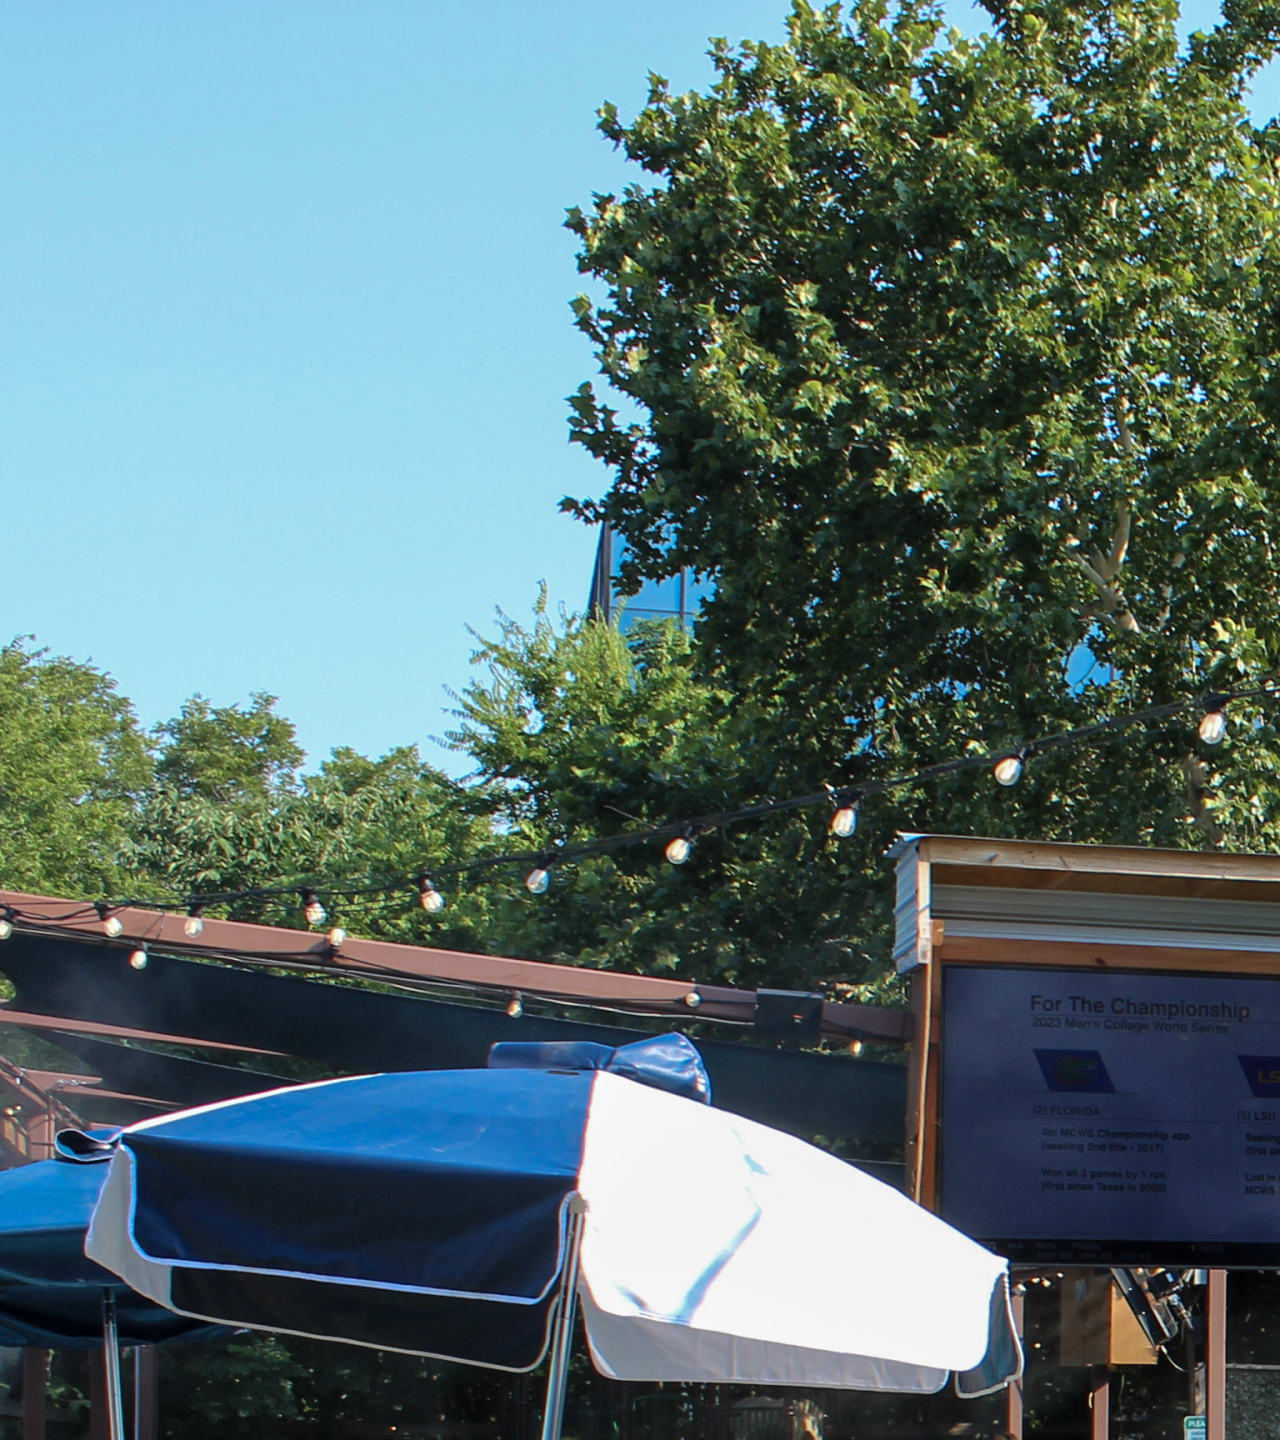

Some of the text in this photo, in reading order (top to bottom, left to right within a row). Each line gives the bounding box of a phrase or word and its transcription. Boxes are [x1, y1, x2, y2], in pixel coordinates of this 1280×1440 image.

[1030, 995, 1250, 1021] For The Championship
[1032, 1017, 1061, 1028] 2023
[1103, 1019, 1149, 1034] College
[1152, 1020, 1188, 1033] World
[1191, 1021, 1229, 1034] Series
[1050, 1106, 1101, 1116] FLORIDA
[1254, 1111, 1277, 1122] LSU
[1060, 1128, 1095, 1138] MCWS
[1097, 1128, 1169, 1141] Championship
